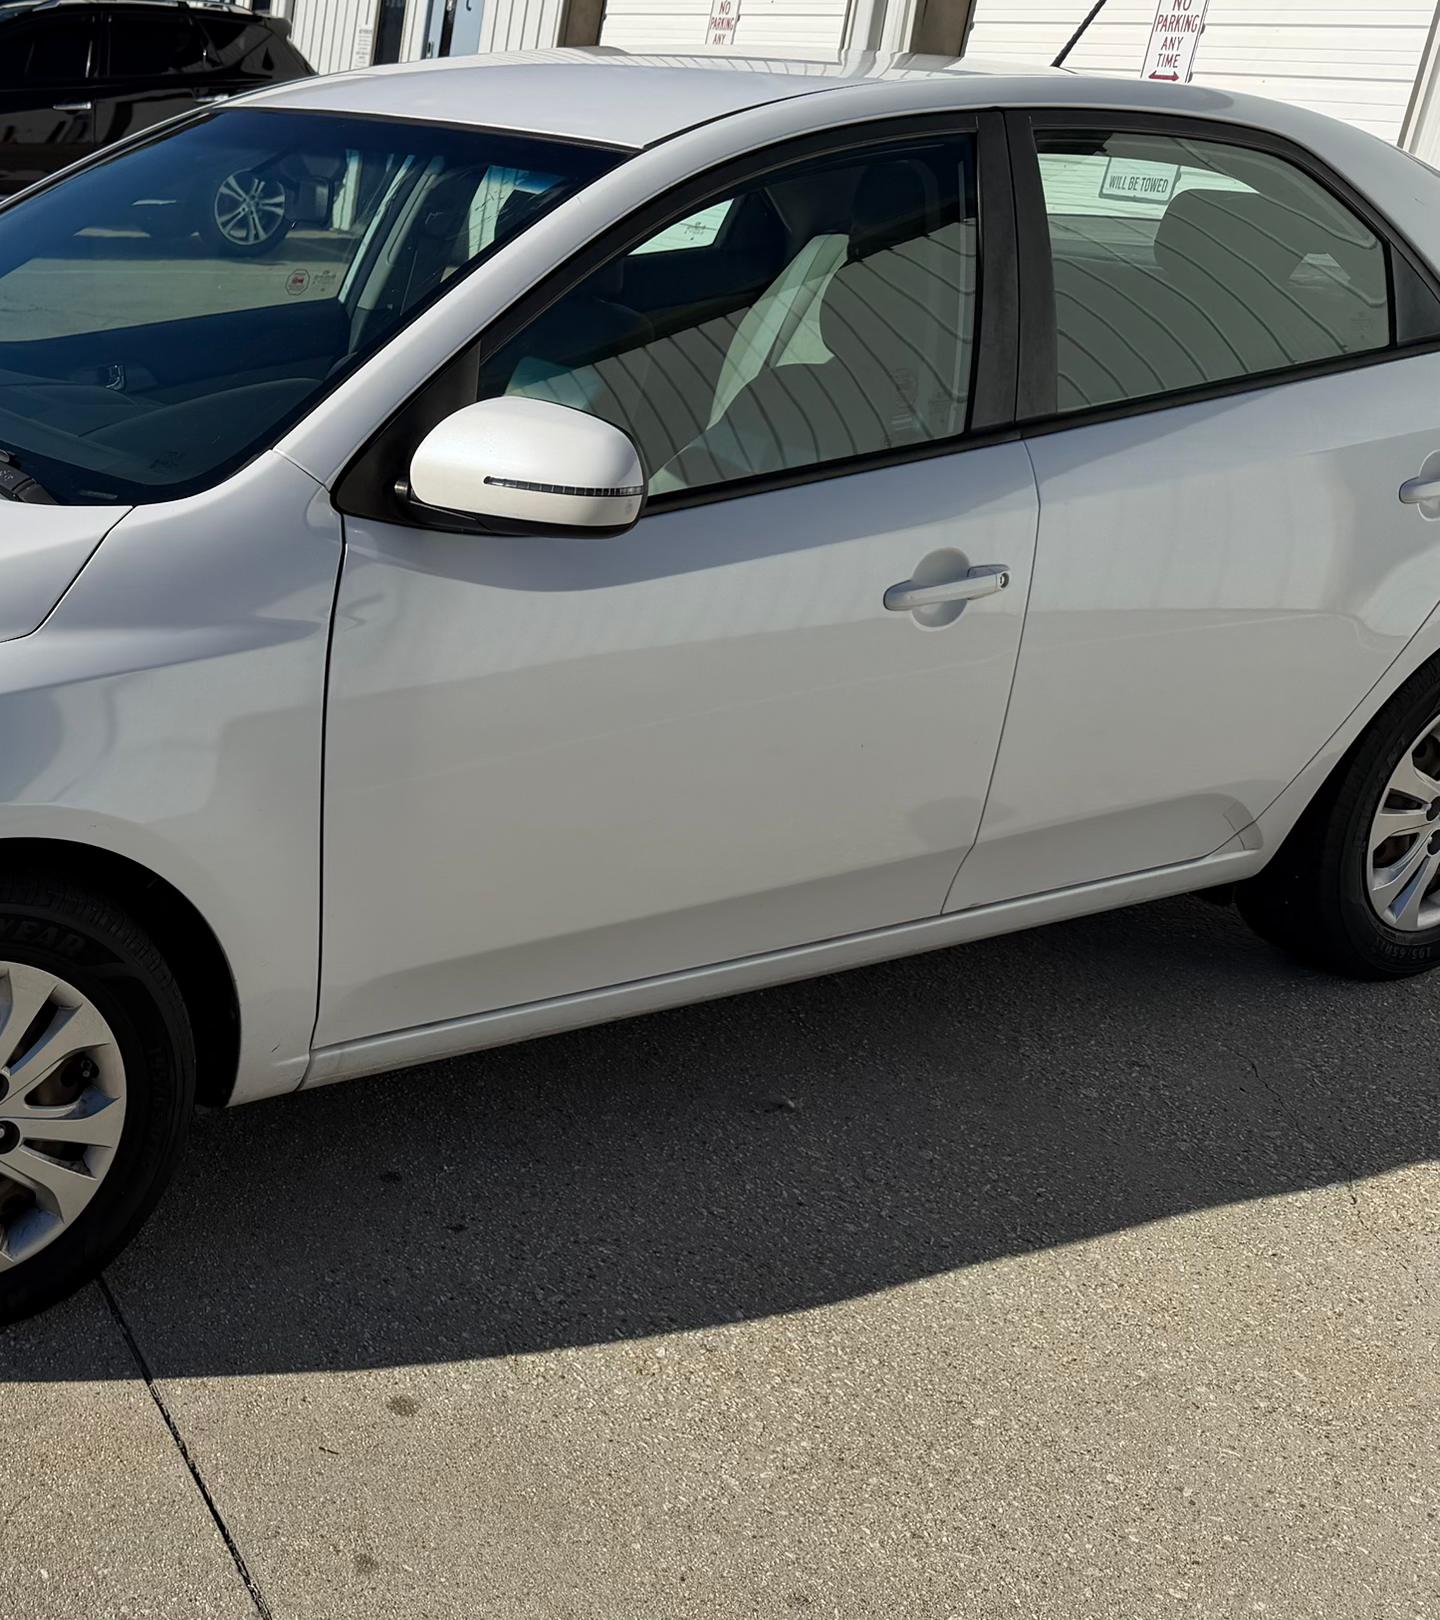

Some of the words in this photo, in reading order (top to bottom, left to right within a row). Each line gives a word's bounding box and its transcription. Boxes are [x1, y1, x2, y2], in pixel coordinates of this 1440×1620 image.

[718, 0, 732, 15] NO
[1172, 0, 1193, 11] NO
[1154, 14, 1200, 33] PARKING
[712, 33, 727, 46] ANY
[1160, 36, 1184, 51] ANY
[1156, 53, 1181, 69] TIME
[1108, 175, 1128, 191] WILL
[1127, 176, 1141, 192] BE
[1140, 177, 1169, 194] TOWED
